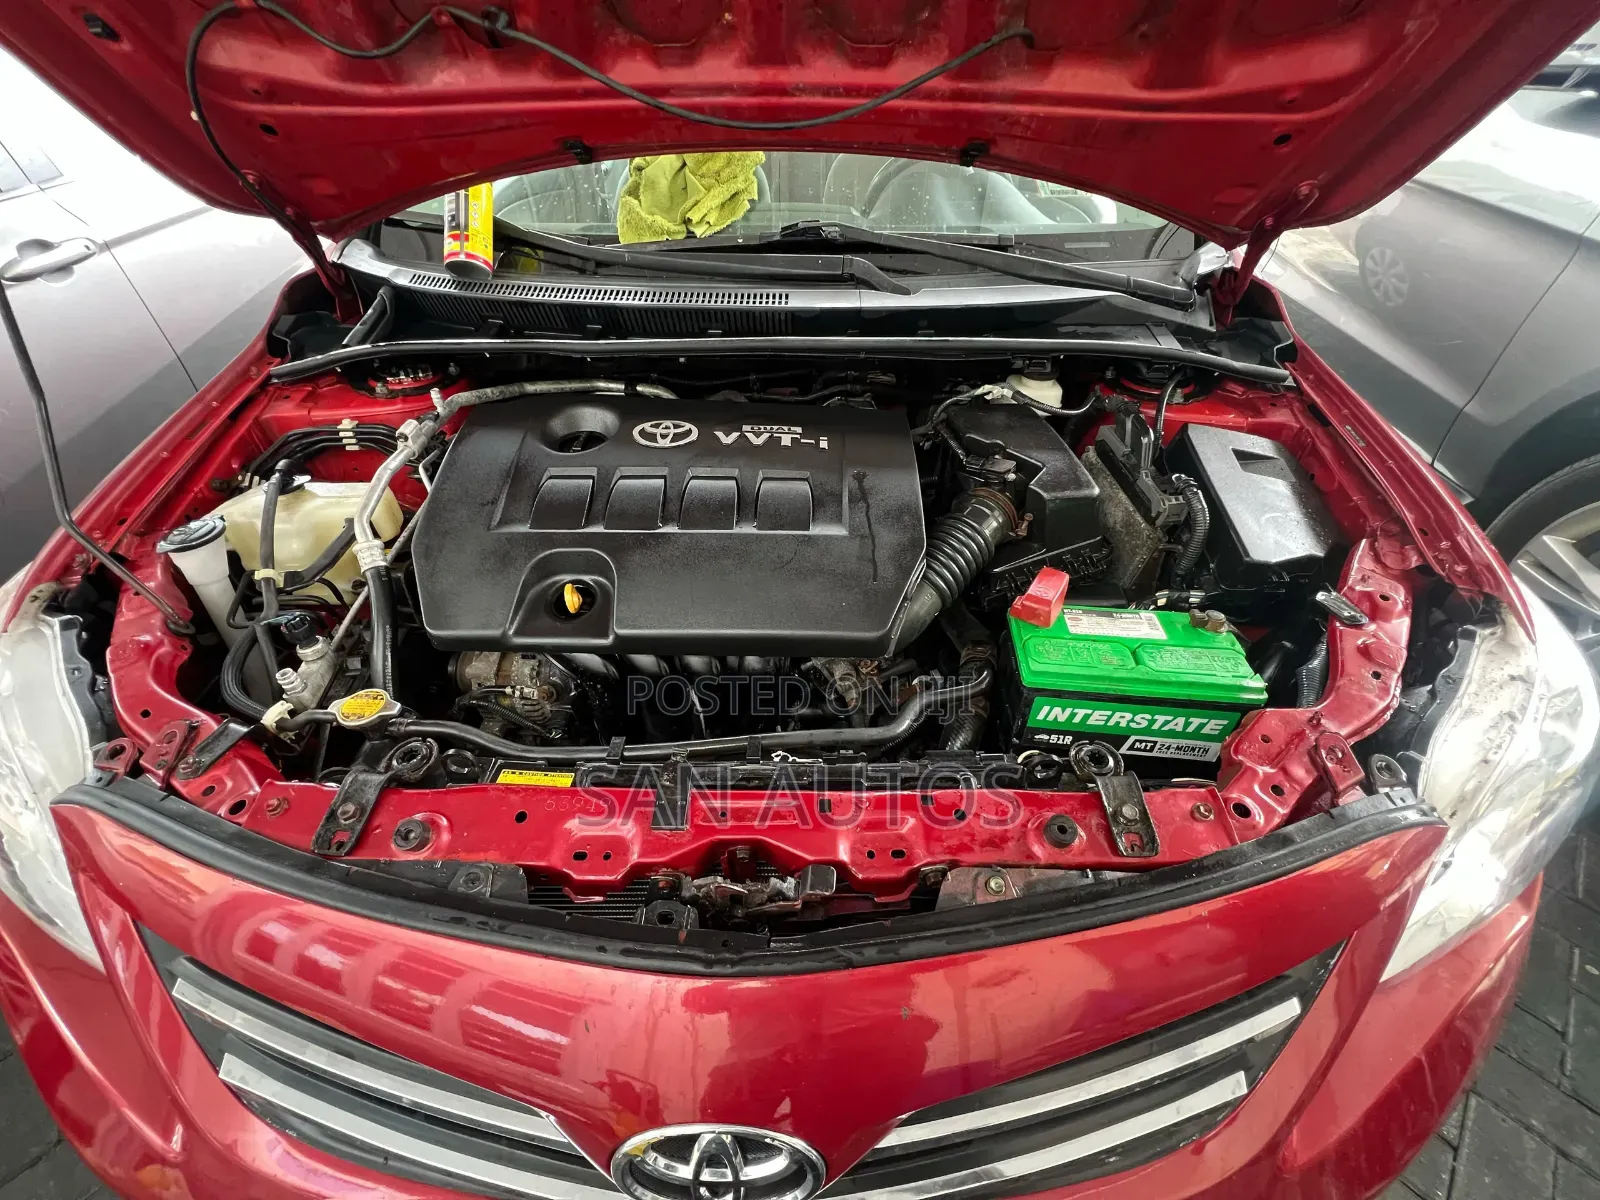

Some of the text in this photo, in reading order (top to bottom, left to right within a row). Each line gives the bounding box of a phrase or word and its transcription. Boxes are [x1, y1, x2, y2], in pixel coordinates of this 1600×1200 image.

[713, 431, 829, 450] VVT-i
[1037, 705, 1229, 734] INTERSTATE
[1049, 734, 1073, 745] 51R
[1133, 741, 1154, 750] MT
[1157, 744, 1210, 755] 24-MONTH
